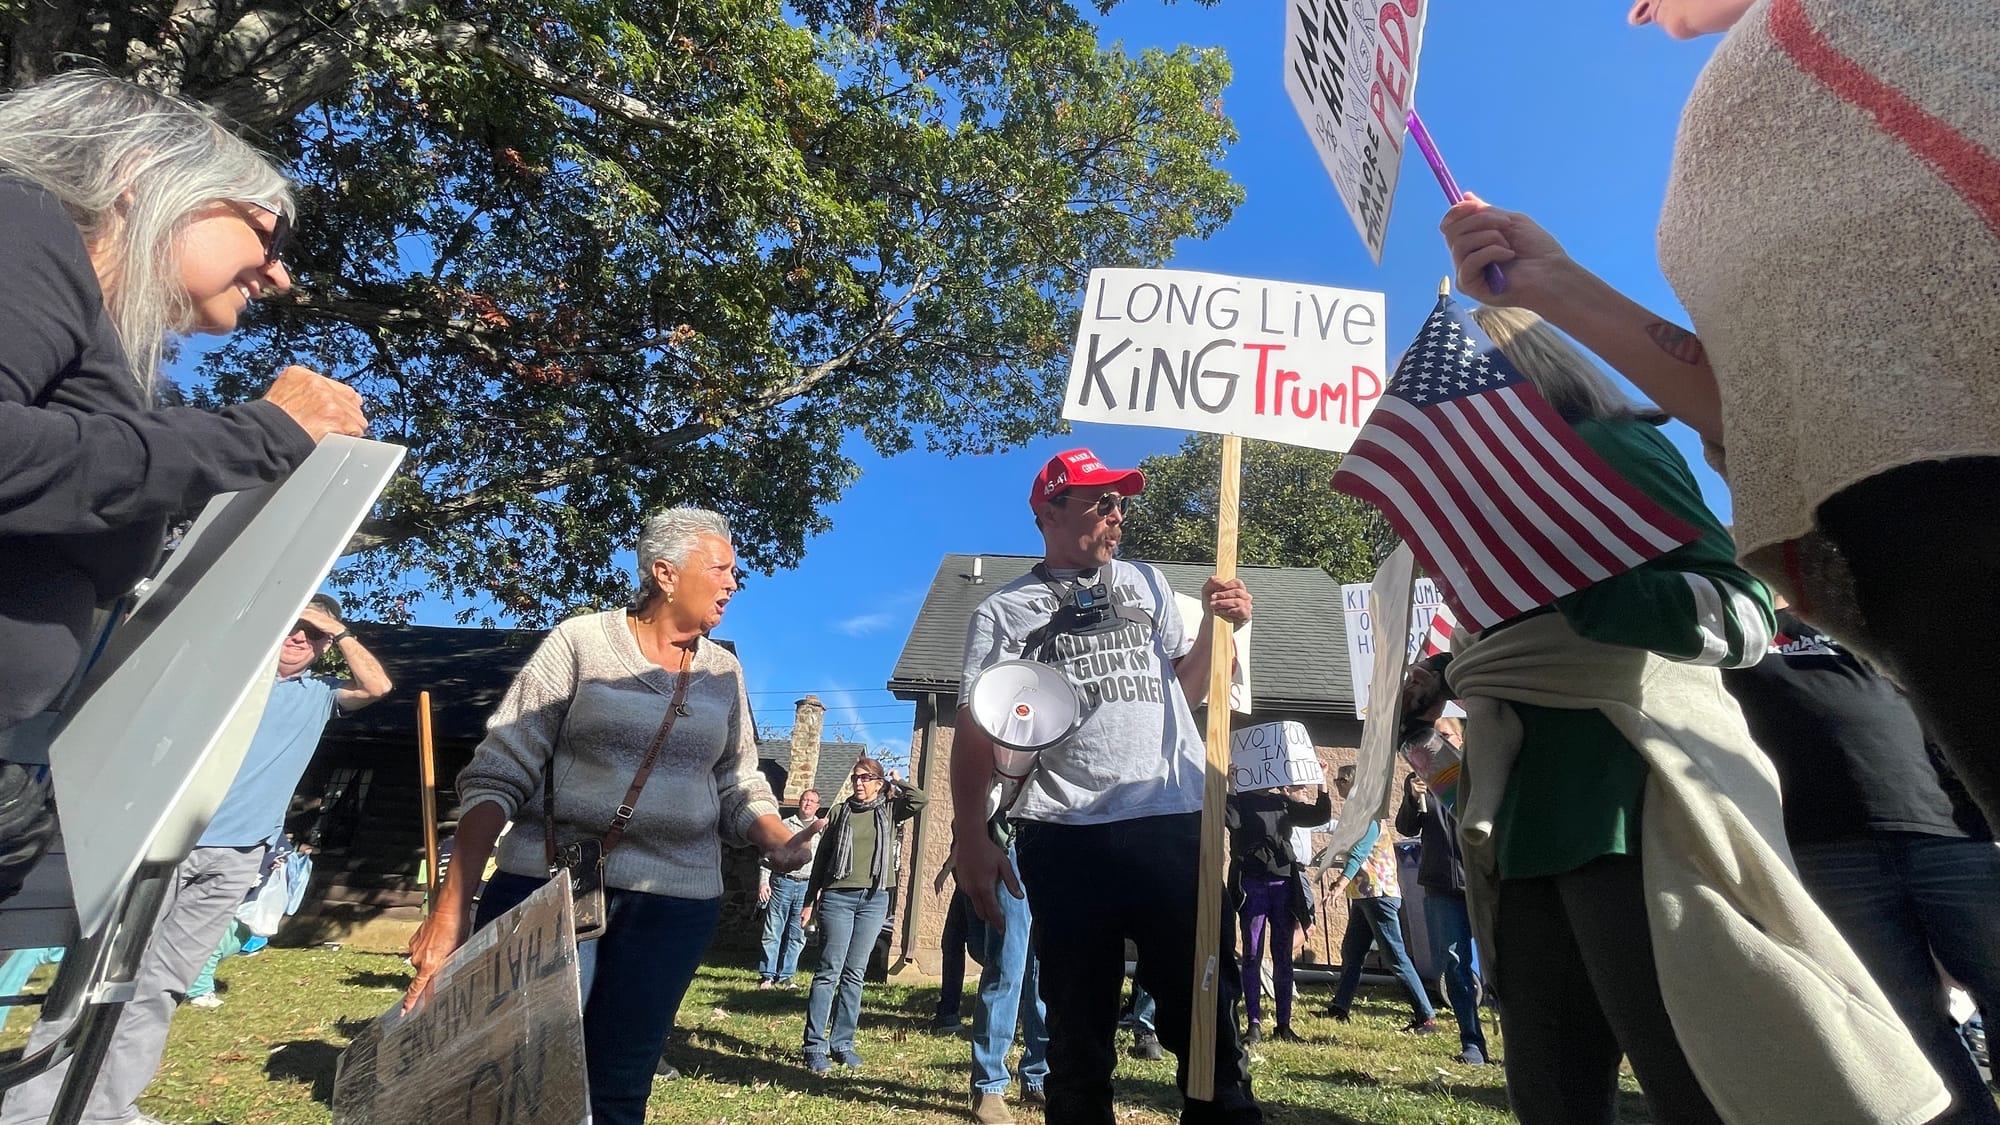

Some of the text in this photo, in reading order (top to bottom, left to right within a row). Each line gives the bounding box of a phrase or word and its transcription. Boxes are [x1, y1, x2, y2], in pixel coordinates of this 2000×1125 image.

[1358, 123, 1380, 228] MORE
[1095, 278, 1240, 330] LONG
[1043, 471, 1068, 496] 45-47
[1072, 652, 1126, 680] GUN
[1230, 727, 1265, 753] NO
[1259, 743, 1289, 761] IN
[1234, 761, 1281, 787] OUR
[485, 910, 574, 1017] THAT
